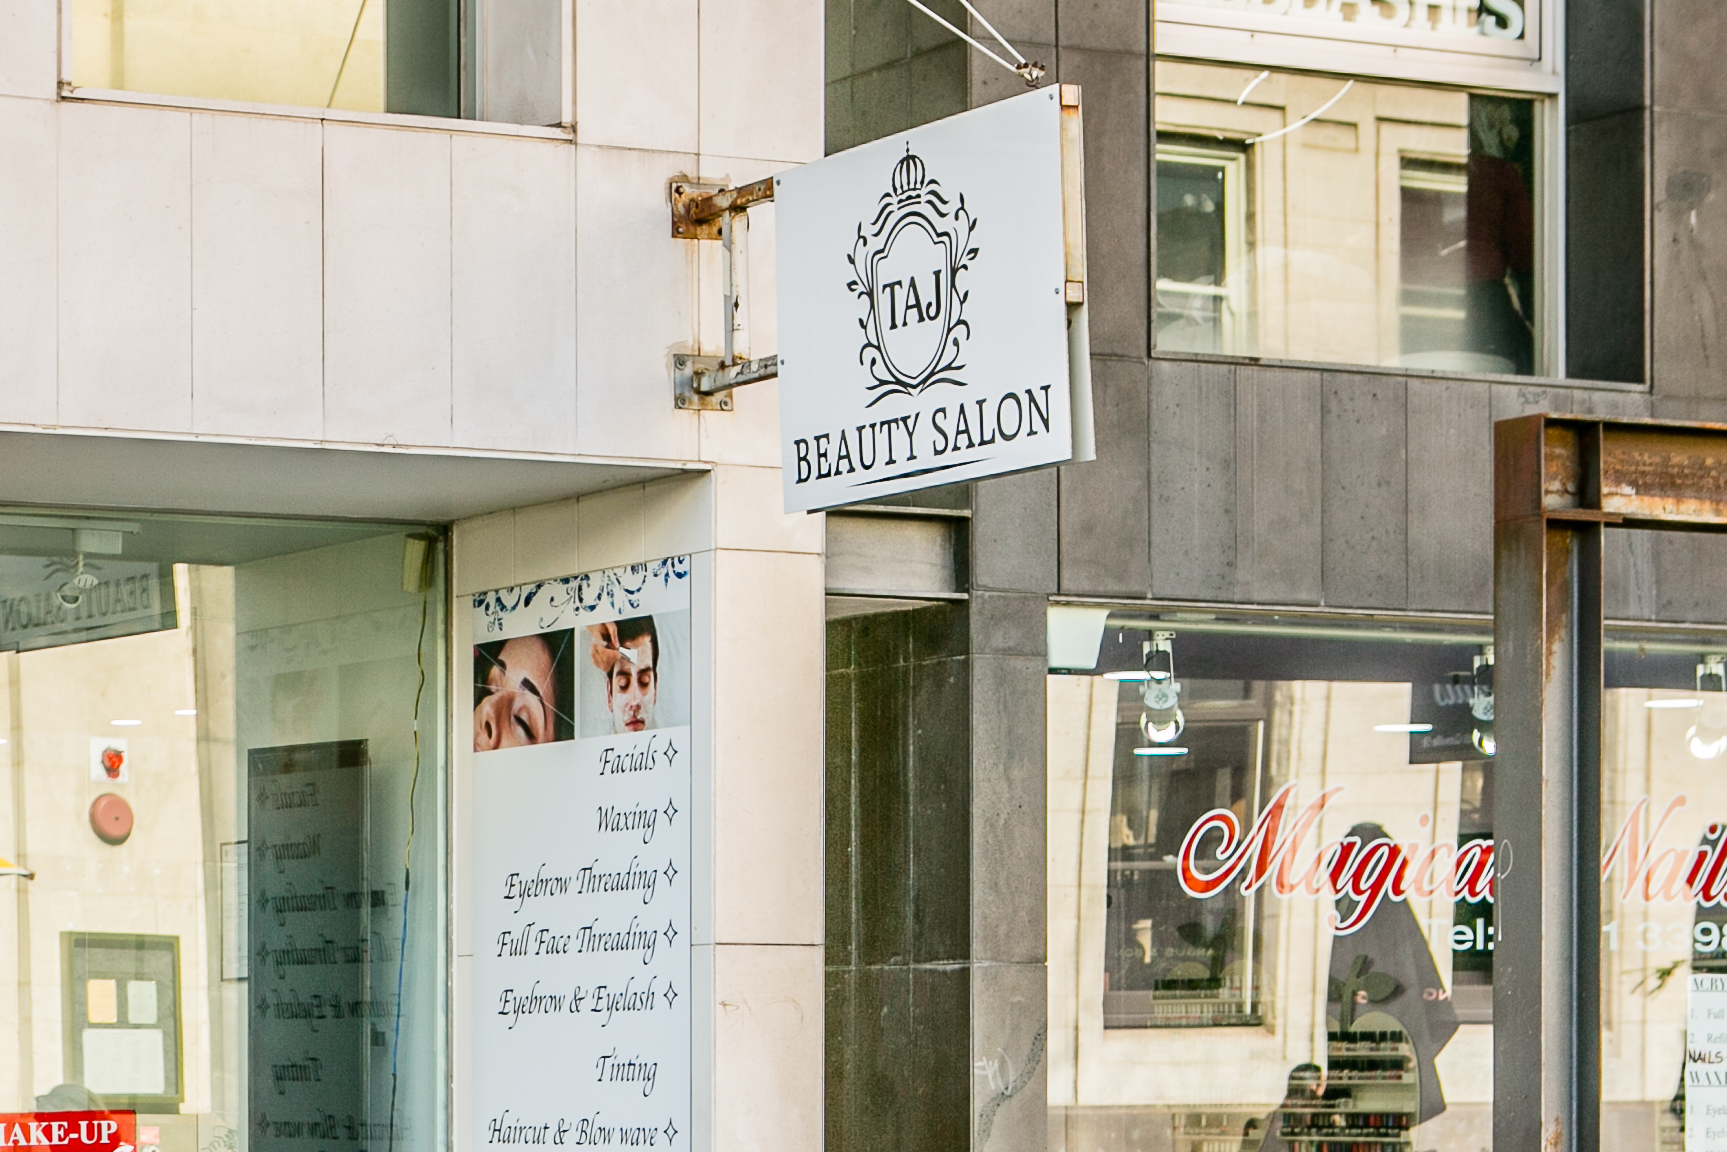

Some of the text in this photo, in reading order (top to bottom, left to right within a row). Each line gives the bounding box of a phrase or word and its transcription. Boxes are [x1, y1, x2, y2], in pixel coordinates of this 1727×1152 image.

[882, 269, 943, 331] TAJ
[793, 384, 1052, 485] BEAUTY SALON
[599, 734, 658, 776] Facials
[596, 802, 658, 844] Waxing
[503, 855, 658, 914] Eyebrow Threading
[497, 915, 658, 966] Full Face Threading
[1421, 917, 1495, 951] Tel:
[497, 975, 657, 1030] Eyebrow & Eyelash
[1707, 1007, 1725, 1020] Full
[595, 1047, 658, 1098] Tinting
[1687, 1047, 1724, 1064] NAILS
[488, 1109, 658, 1147] Haircut & Blow wave
